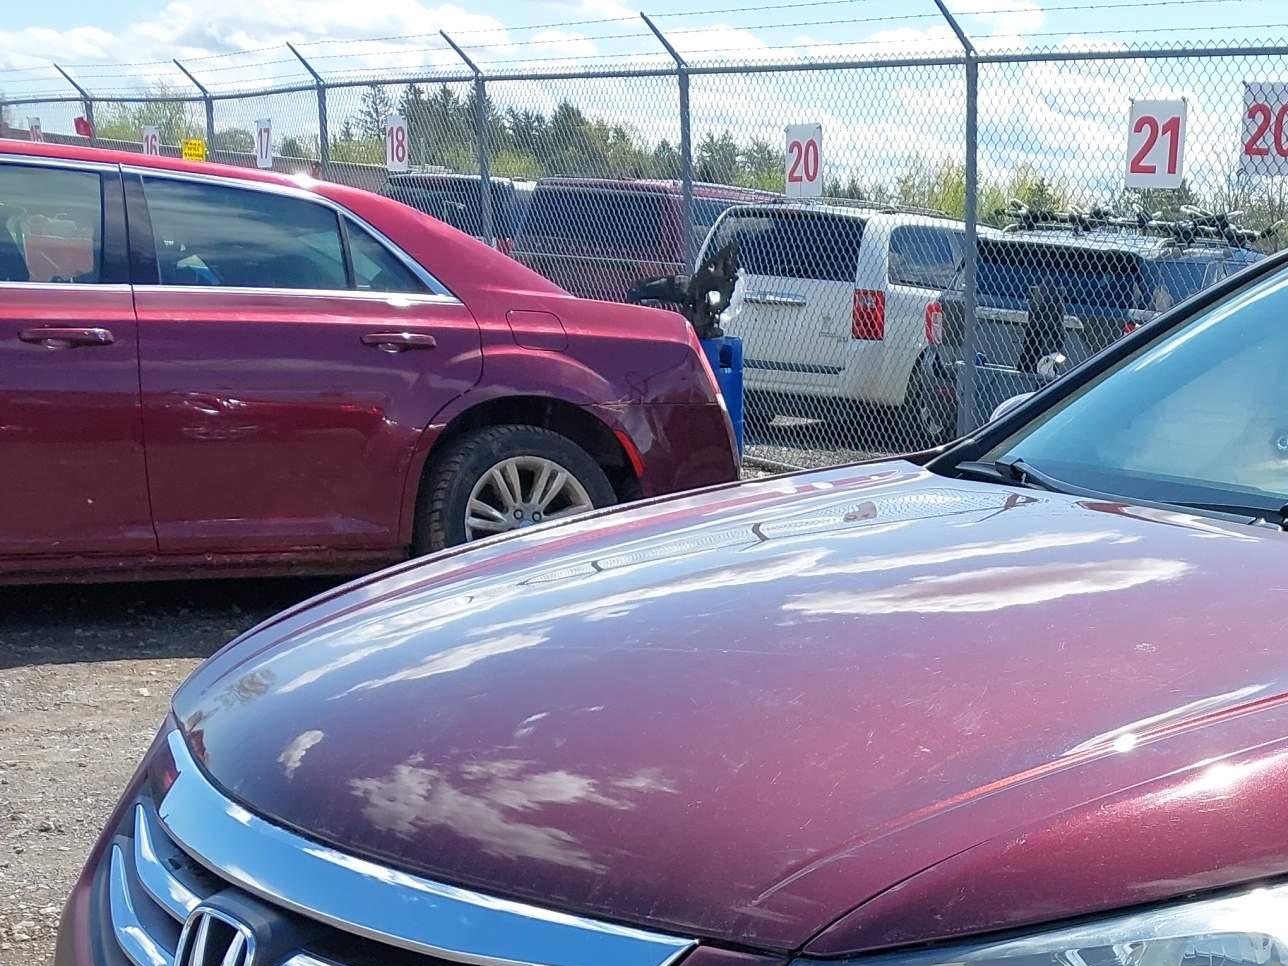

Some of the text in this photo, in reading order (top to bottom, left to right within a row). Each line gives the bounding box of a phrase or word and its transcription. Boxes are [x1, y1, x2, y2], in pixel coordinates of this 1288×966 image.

[145, 134, 157, 156] 16
[258, 127, 270, 159] 17
[388, 126, 405, 162] 18
[788, 139, 818, 182] 20
[1130, 116, 1181, 174] 21
